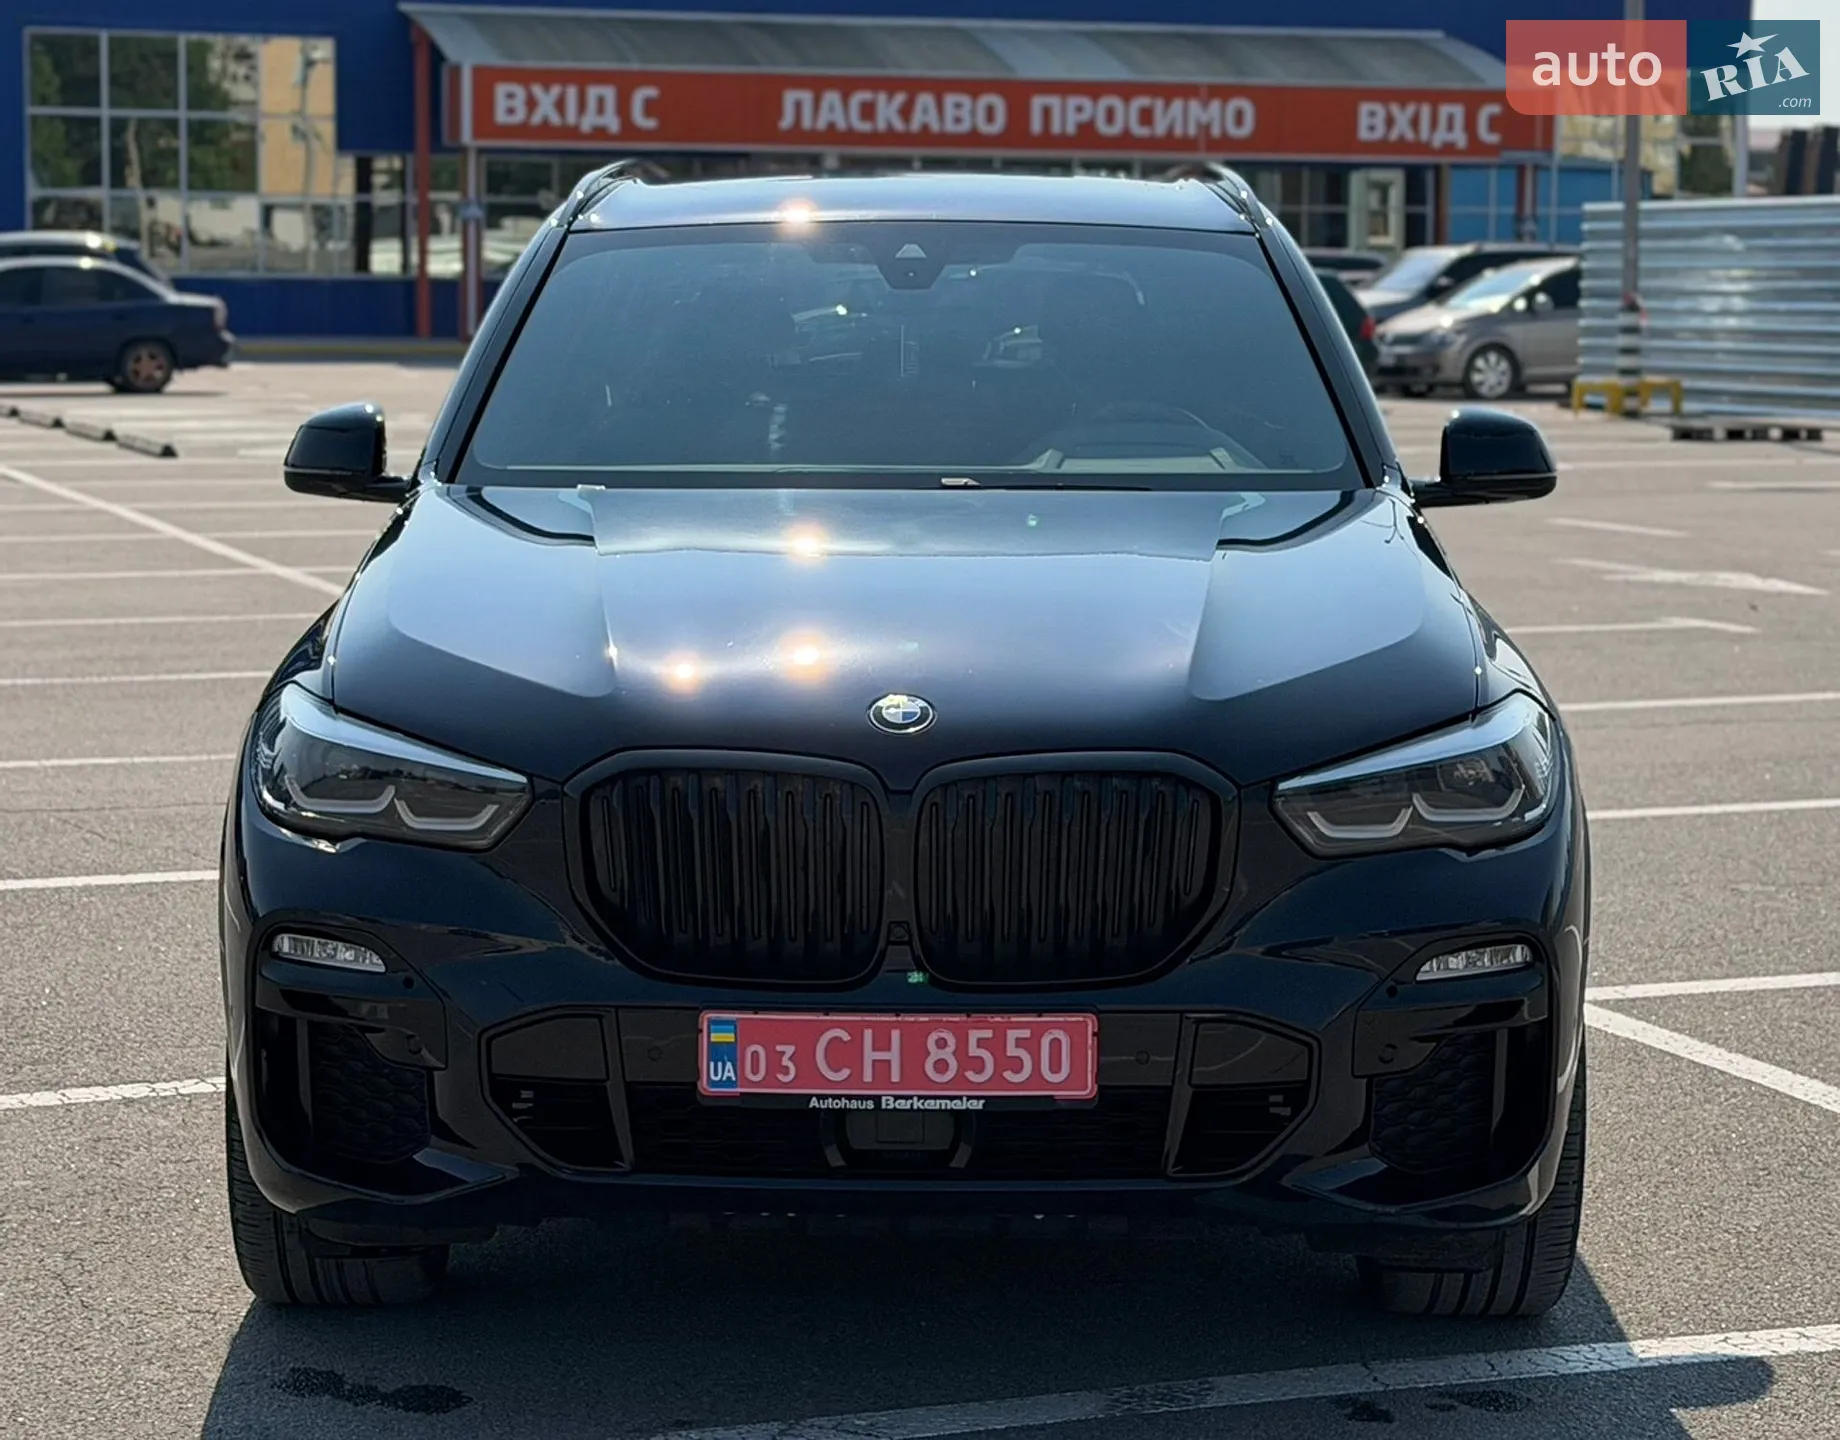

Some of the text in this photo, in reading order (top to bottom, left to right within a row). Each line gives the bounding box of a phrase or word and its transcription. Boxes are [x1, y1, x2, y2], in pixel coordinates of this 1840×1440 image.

[493, 81, 661, 135] ВХІД С
[778, 89, 1257, 139] ЛАСКАВО ПРОСИМО
[1356, 100, 1504, 151] ВХІД С
[709, 1061, 736, 1083] UA
[743, 1027, 1072, 1084] 03 CH 8550
[808, 1096, 875, 1110] Autohaus
